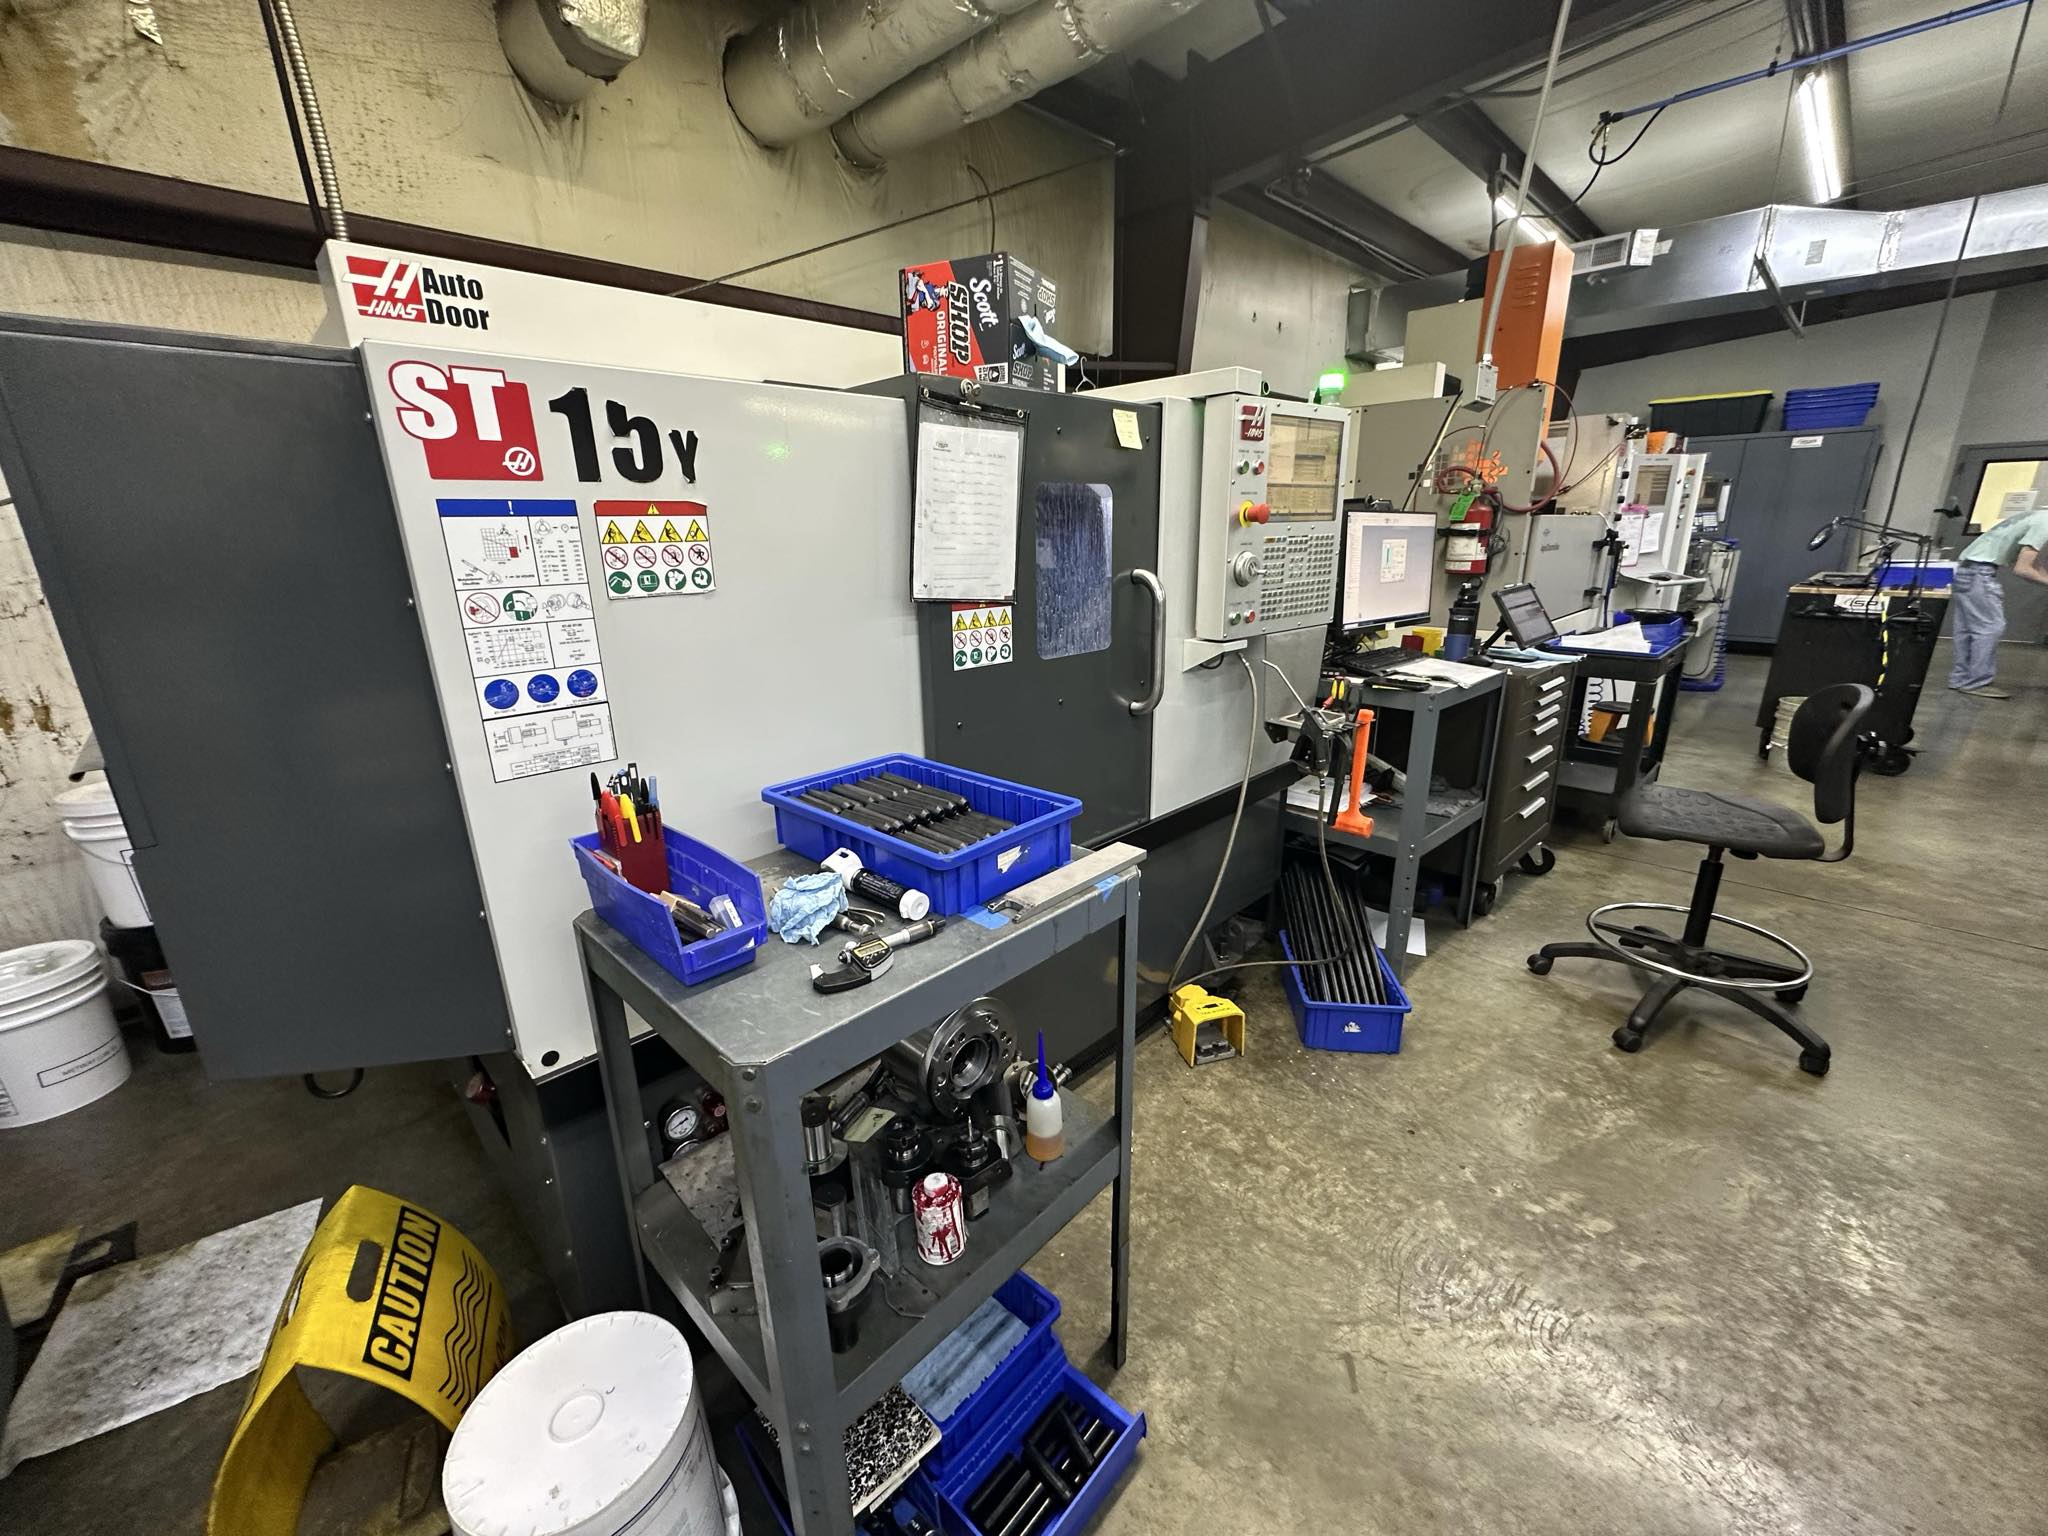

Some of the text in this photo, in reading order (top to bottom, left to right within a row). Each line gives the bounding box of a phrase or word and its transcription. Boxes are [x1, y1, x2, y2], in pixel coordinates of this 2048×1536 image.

[357, 299, 424, 319] HAAS
[422, 267, 484, 301] Auto
[969, 277, 999, 328] Scott
[425, 298, 490, 331] Door
[936, 311, 948, 375] ORIGINAL
[948, 281, 971, 364] SHOP
[388, 360, 506, 442] ST
[371, 1211, 436, 1371] CAUTION
